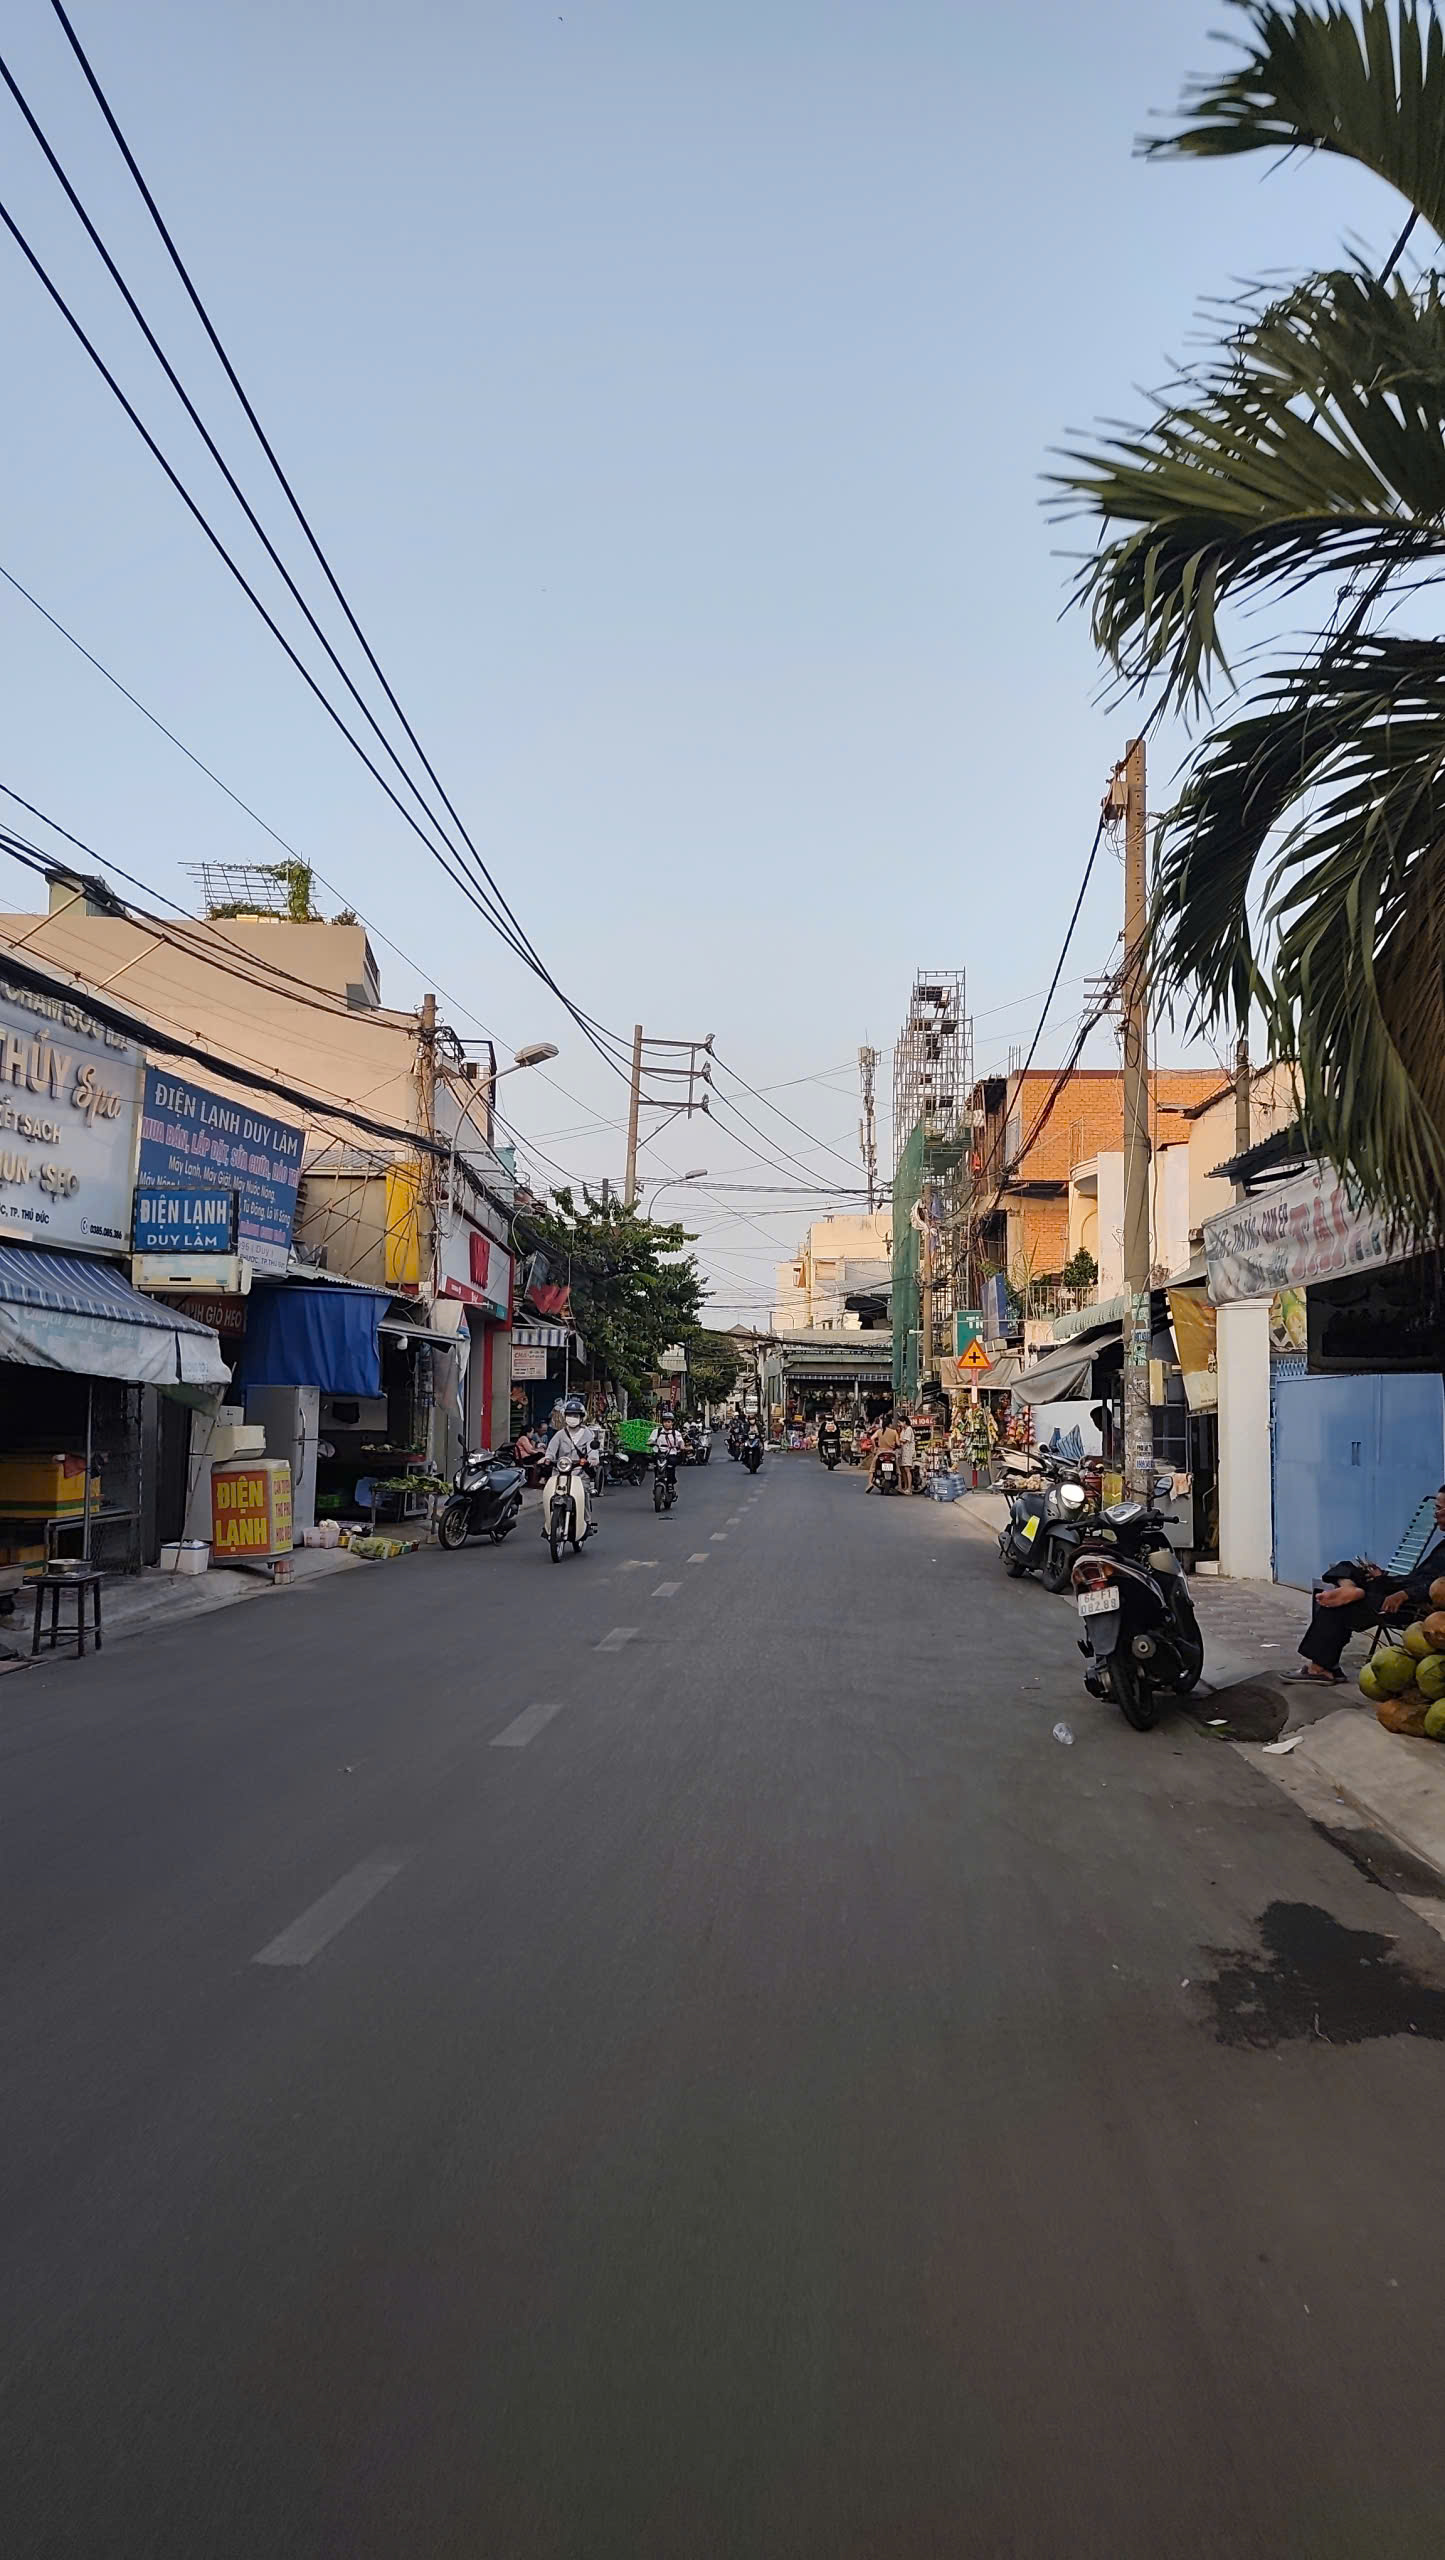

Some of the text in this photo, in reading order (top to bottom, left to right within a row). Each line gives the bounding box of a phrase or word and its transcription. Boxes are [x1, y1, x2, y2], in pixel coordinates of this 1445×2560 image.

[0, 1027, 121, 1128] HÚY Spa
[22, 1114, 61, 1144] SẠCH
[141, 1116, 165, 1143] MUA
[155, 1082, 298, 1158] ĐIỆN LẠNH DUY LÂM
[168, 1155, 183, 1175] Máy
[203, 1166, 217, 1185] Máy
[140, 1194, 227, 1230] ĐIỆN LẠNH
[147, 1231, 217, 1247] DUY LÂM
[223, 1308, 242, 1328] HEO
[216, 1475, 264, 1514] ĐIỆN
[215, 1518, 268, 1552] LẠNH
